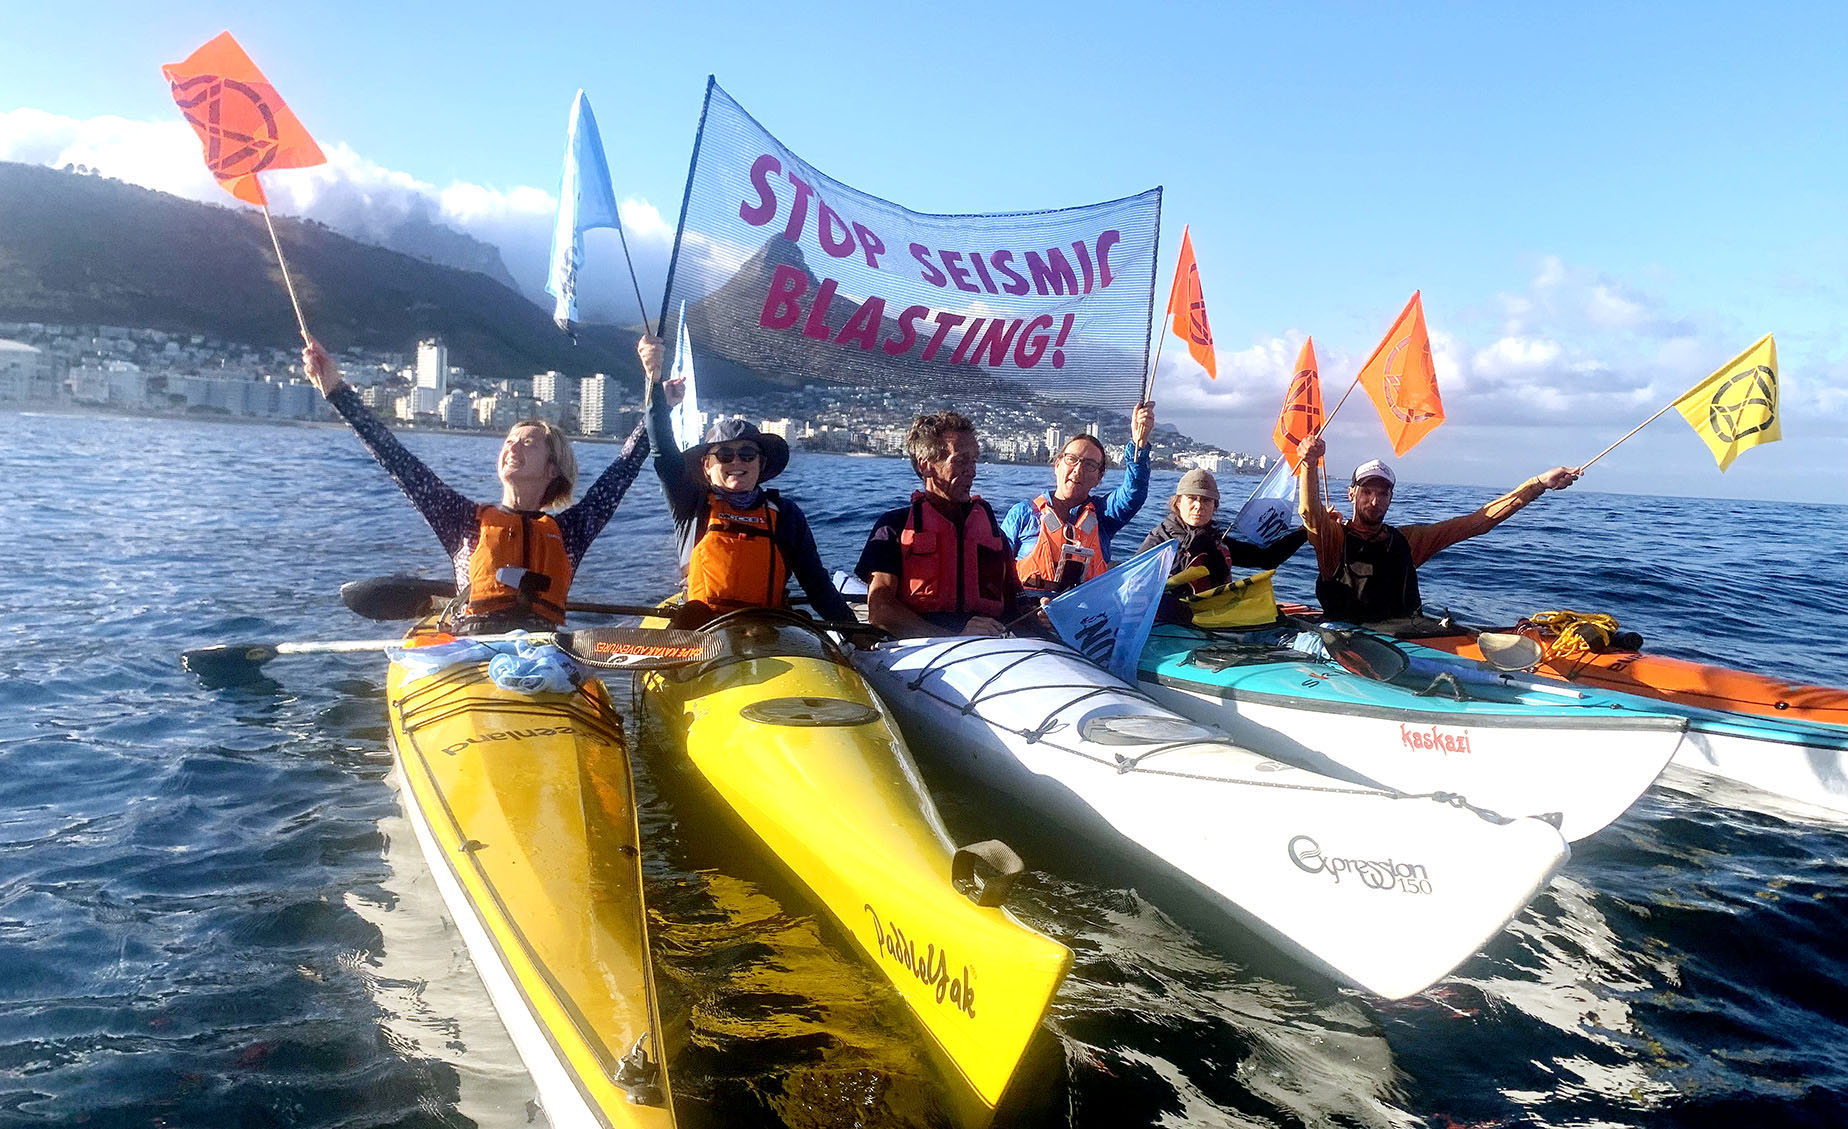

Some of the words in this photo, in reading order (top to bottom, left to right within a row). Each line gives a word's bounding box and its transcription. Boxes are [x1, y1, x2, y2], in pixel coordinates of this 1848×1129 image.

[739, 153, 886, 269] STOP
[909, 230, 1121, 296] SEISMIC
[759, 264, 1075, 369] BLASTING!
[594, 642, 648, 655] ADVENTURES
[646, 645, 680, 657] KAYAK
[676, 646, 704, 658] CAPE
[1400, 723, 1471, 755] kaskazi
